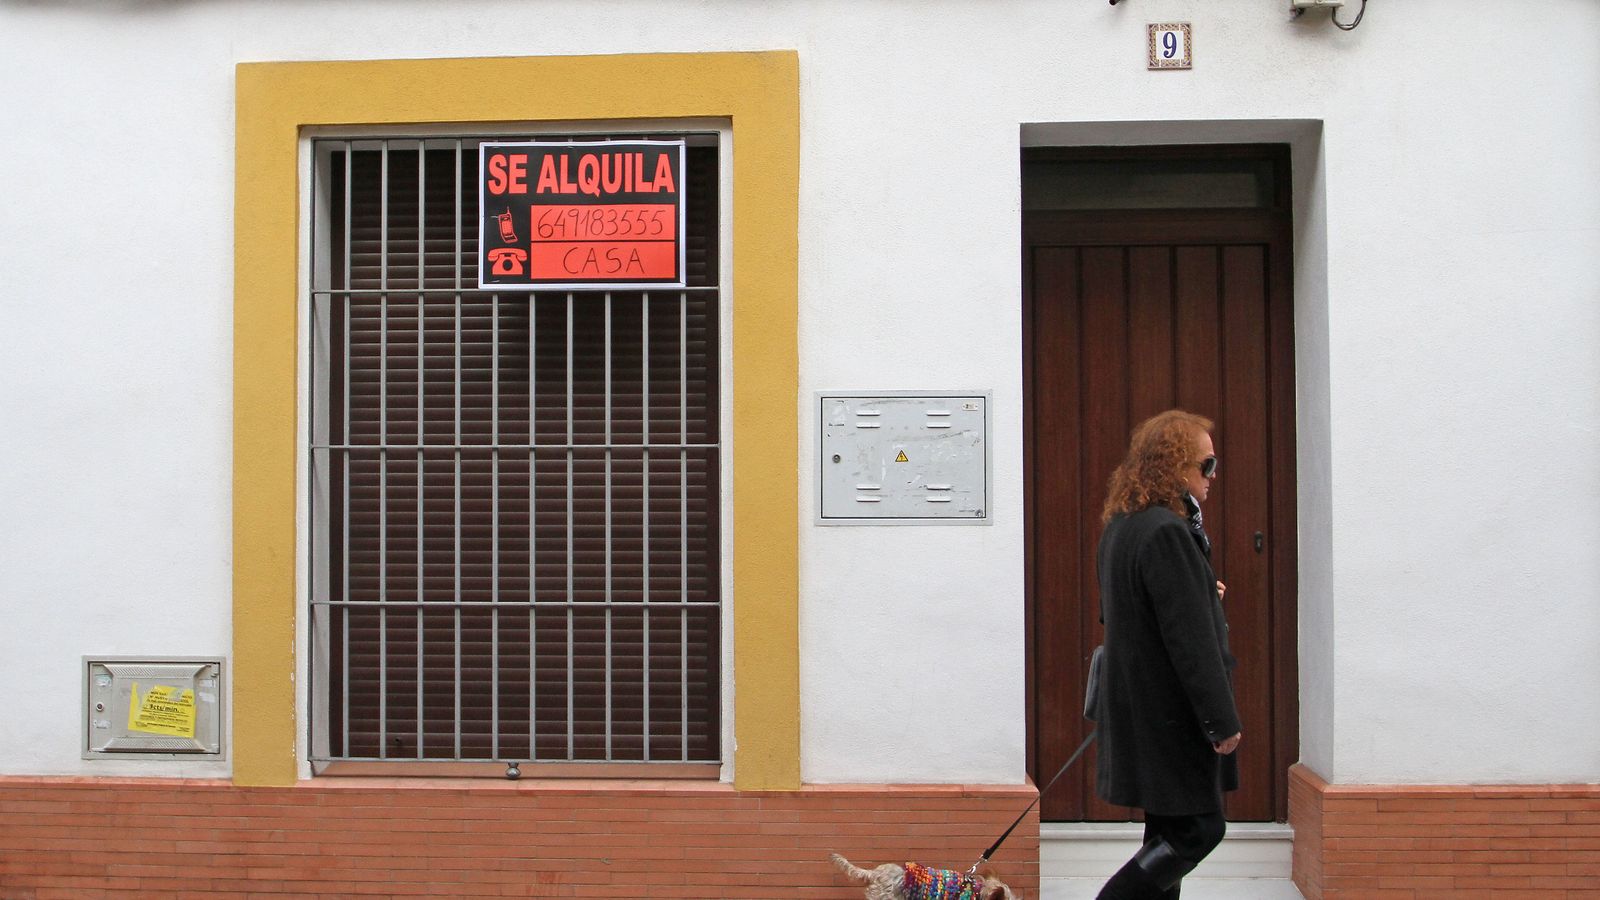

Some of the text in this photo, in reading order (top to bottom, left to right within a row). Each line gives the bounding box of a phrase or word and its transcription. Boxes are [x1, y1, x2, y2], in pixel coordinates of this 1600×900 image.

[1162, 31, 1177, 59] 9
[488, 152, 676, 197] SE ALQUILA
[537, 208, 666, 239] 649183555
[562, 246, 646, 275] CASA
